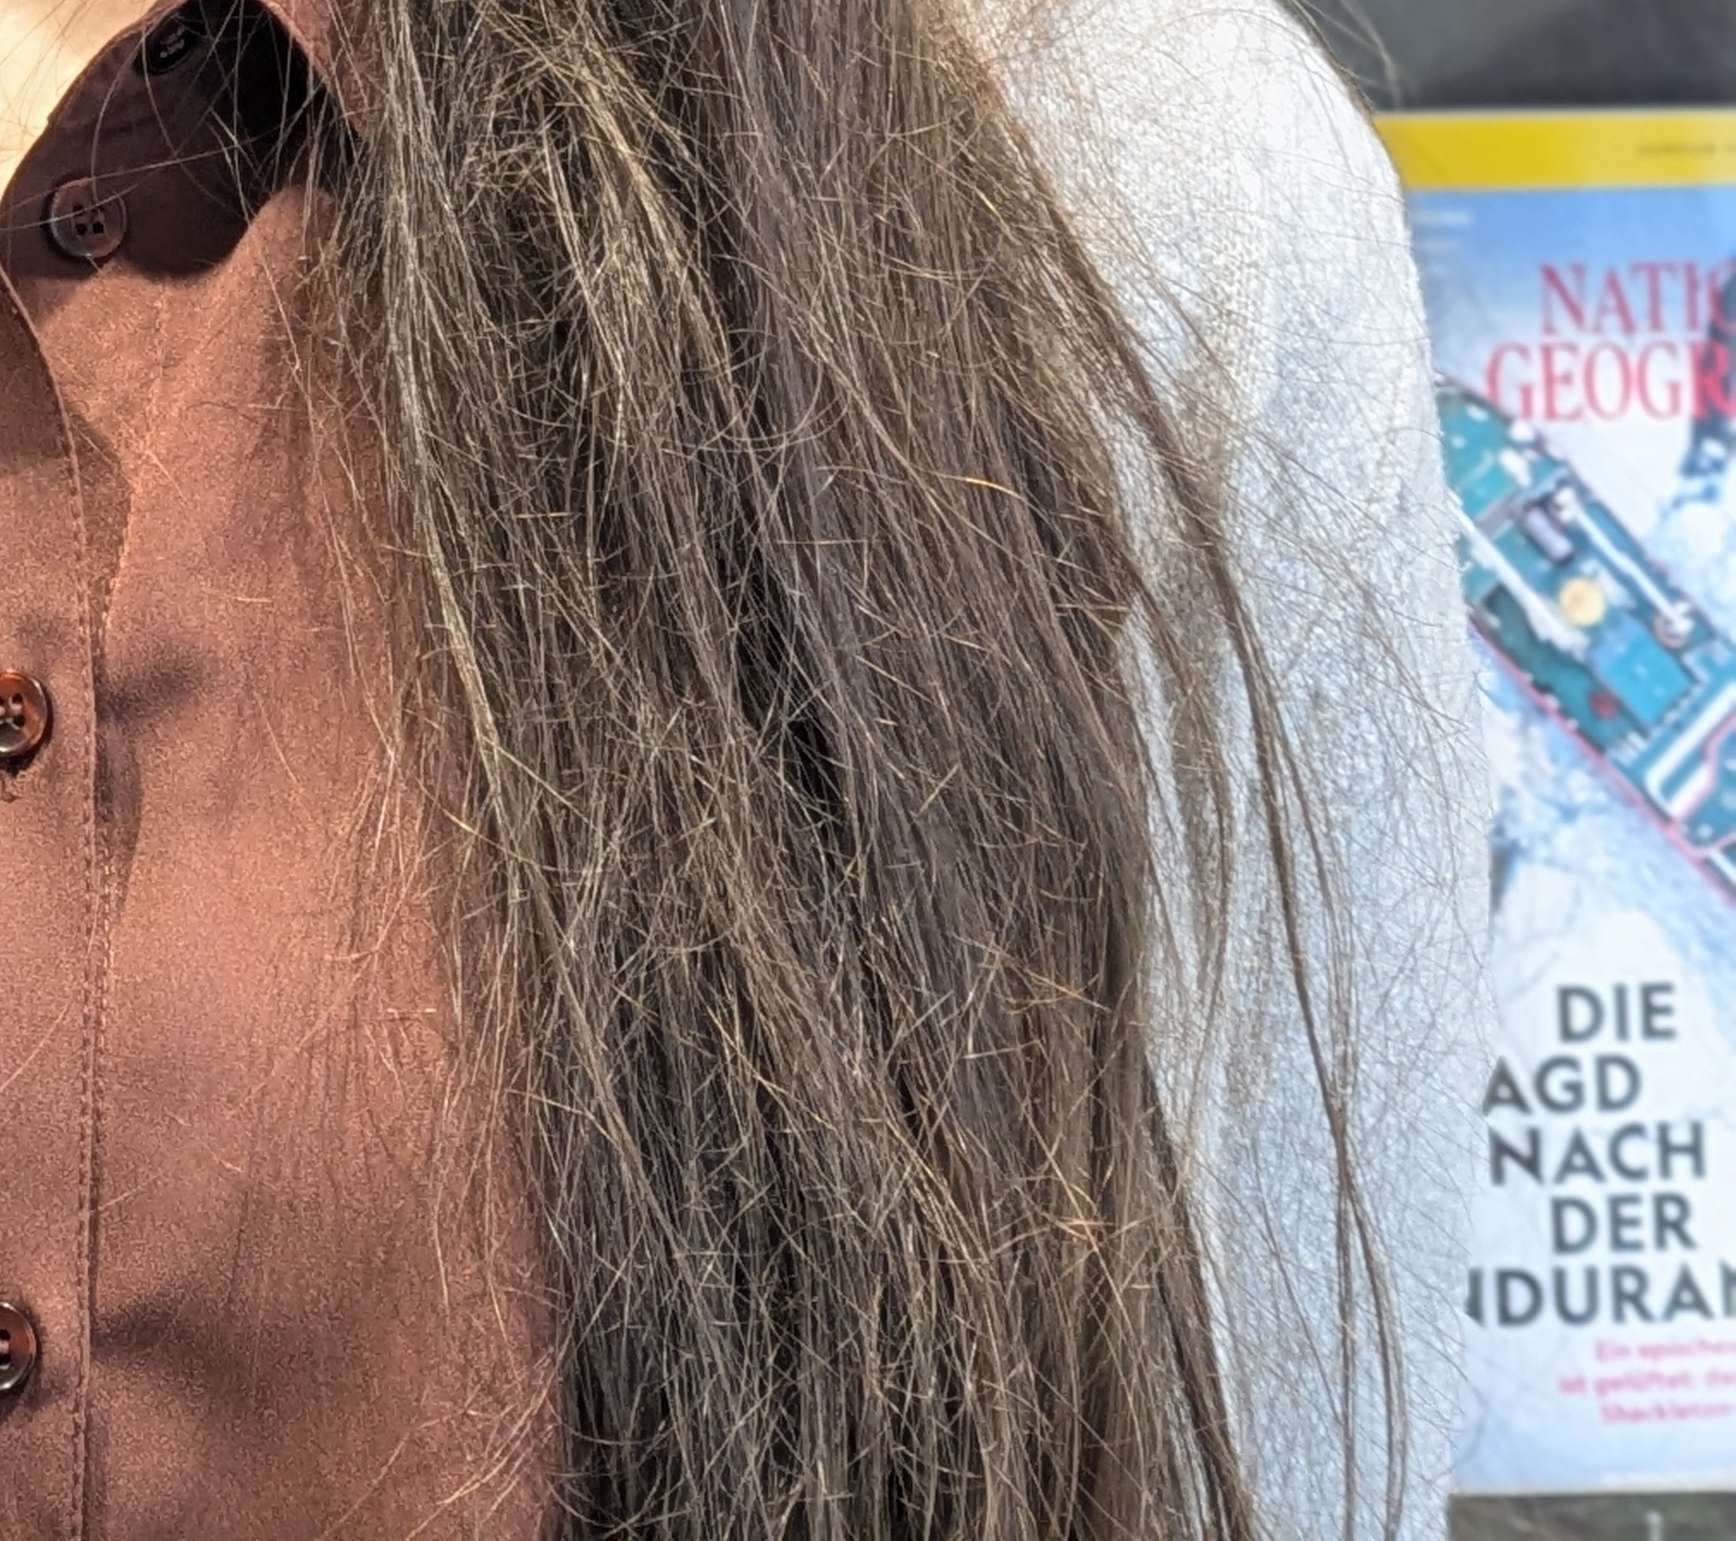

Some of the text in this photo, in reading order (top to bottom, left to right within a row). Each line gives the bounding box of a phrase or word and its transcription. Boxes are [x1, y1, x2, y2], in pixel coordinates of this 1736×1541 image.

[1557, 982, 1676, 1044] DIE
[1488, 1121, 1706, 1186] NACH
[1551, 1193, 1696, 1255] DER
